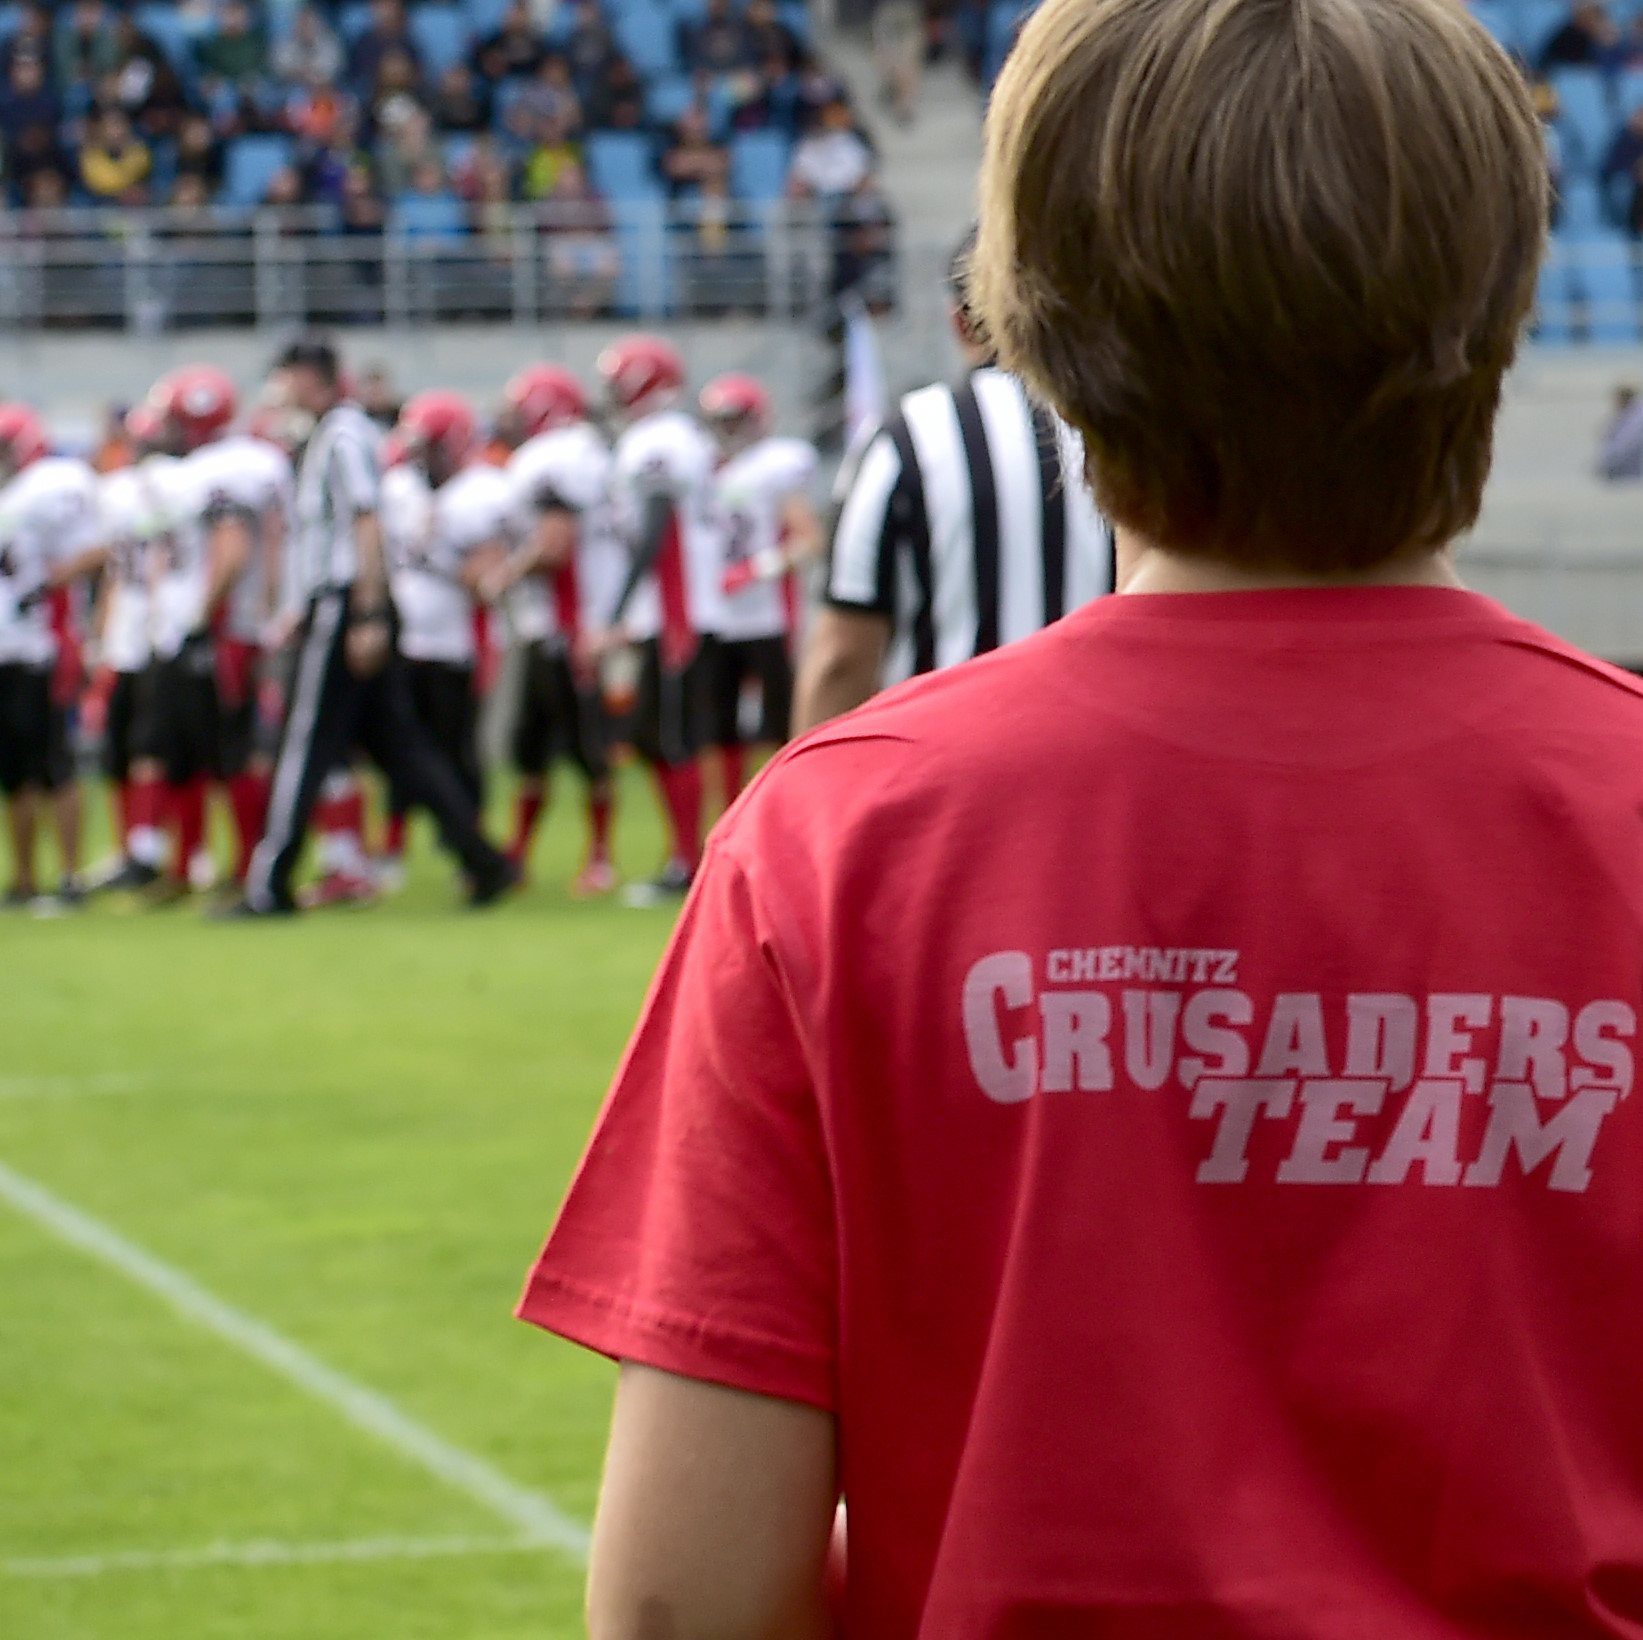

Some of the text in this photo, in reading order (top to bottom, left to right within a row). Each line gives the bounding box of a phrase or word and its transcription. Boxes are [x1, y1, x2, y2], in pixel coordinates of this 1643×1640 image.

[1047, 946, 1239, 982] CHEMNITZ
[962, 950, 1637, 1104] CRUSADERS
[1188, 1077, 1620, 1193] TEAM
